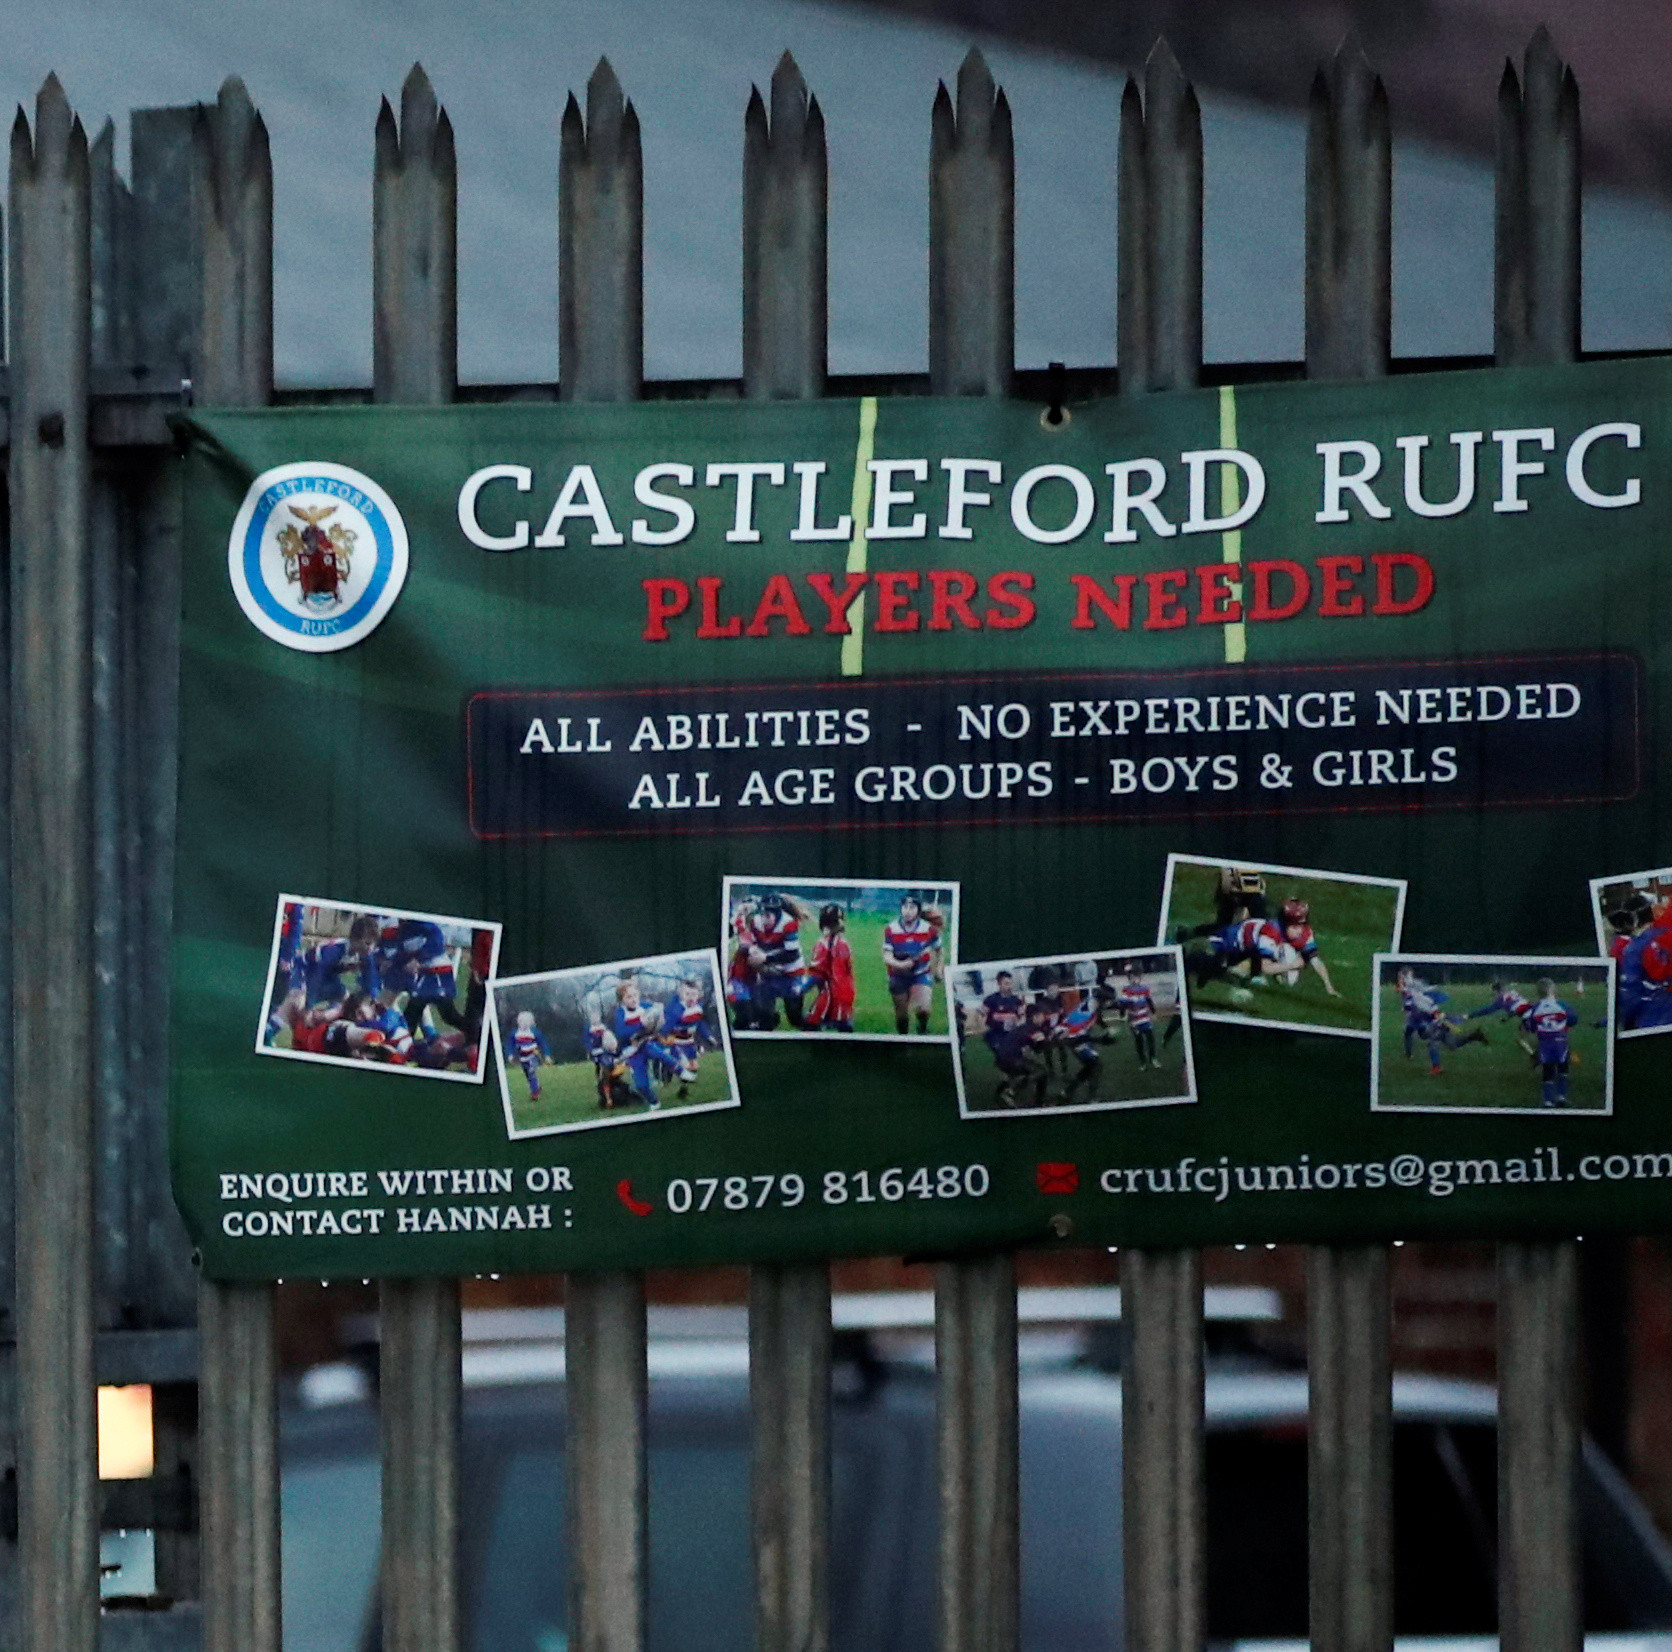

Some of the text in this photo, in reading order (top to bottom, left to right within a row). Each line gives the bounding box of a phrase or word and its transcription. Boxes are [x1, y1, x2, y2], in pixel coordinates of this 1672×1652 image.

[257, 478, 375, 516] CASTLEFORD
[457, 422, 1641, 551] CASTLEFORD RUFC
[642, 552, 1434, 640] PLAYERS NEEDED
[519, 717, 612, 754] ALL
[628, 708, 871, 752] ABILITIES
[956, 703, 1031, 741] NO
[1049, 691, 1356, 738] EXPERIENCE
[1375, 682, 1581, 726] NEEDED
[628, 772, 721, 810] ALL
[737, 768, 835, 806] AGE
[854, 761, 1053, 803] GROUPS
[1109, 754, 1239, 794] BOYS
[1259, 752, 1293, 789] &
[1312, 746, 1458, 787] GIRLS
[219, 1166, 574, 1203] ENQUIRE WITHIN OR
[666, 1164, 990, 1213] 07879 816480
[1100, 1146, 1672, 1202] crufcjuniors@gmail.com
[222, 1208, 385, 1237] CONTACT
[396, 1204, 552, 1233] HANNAH
